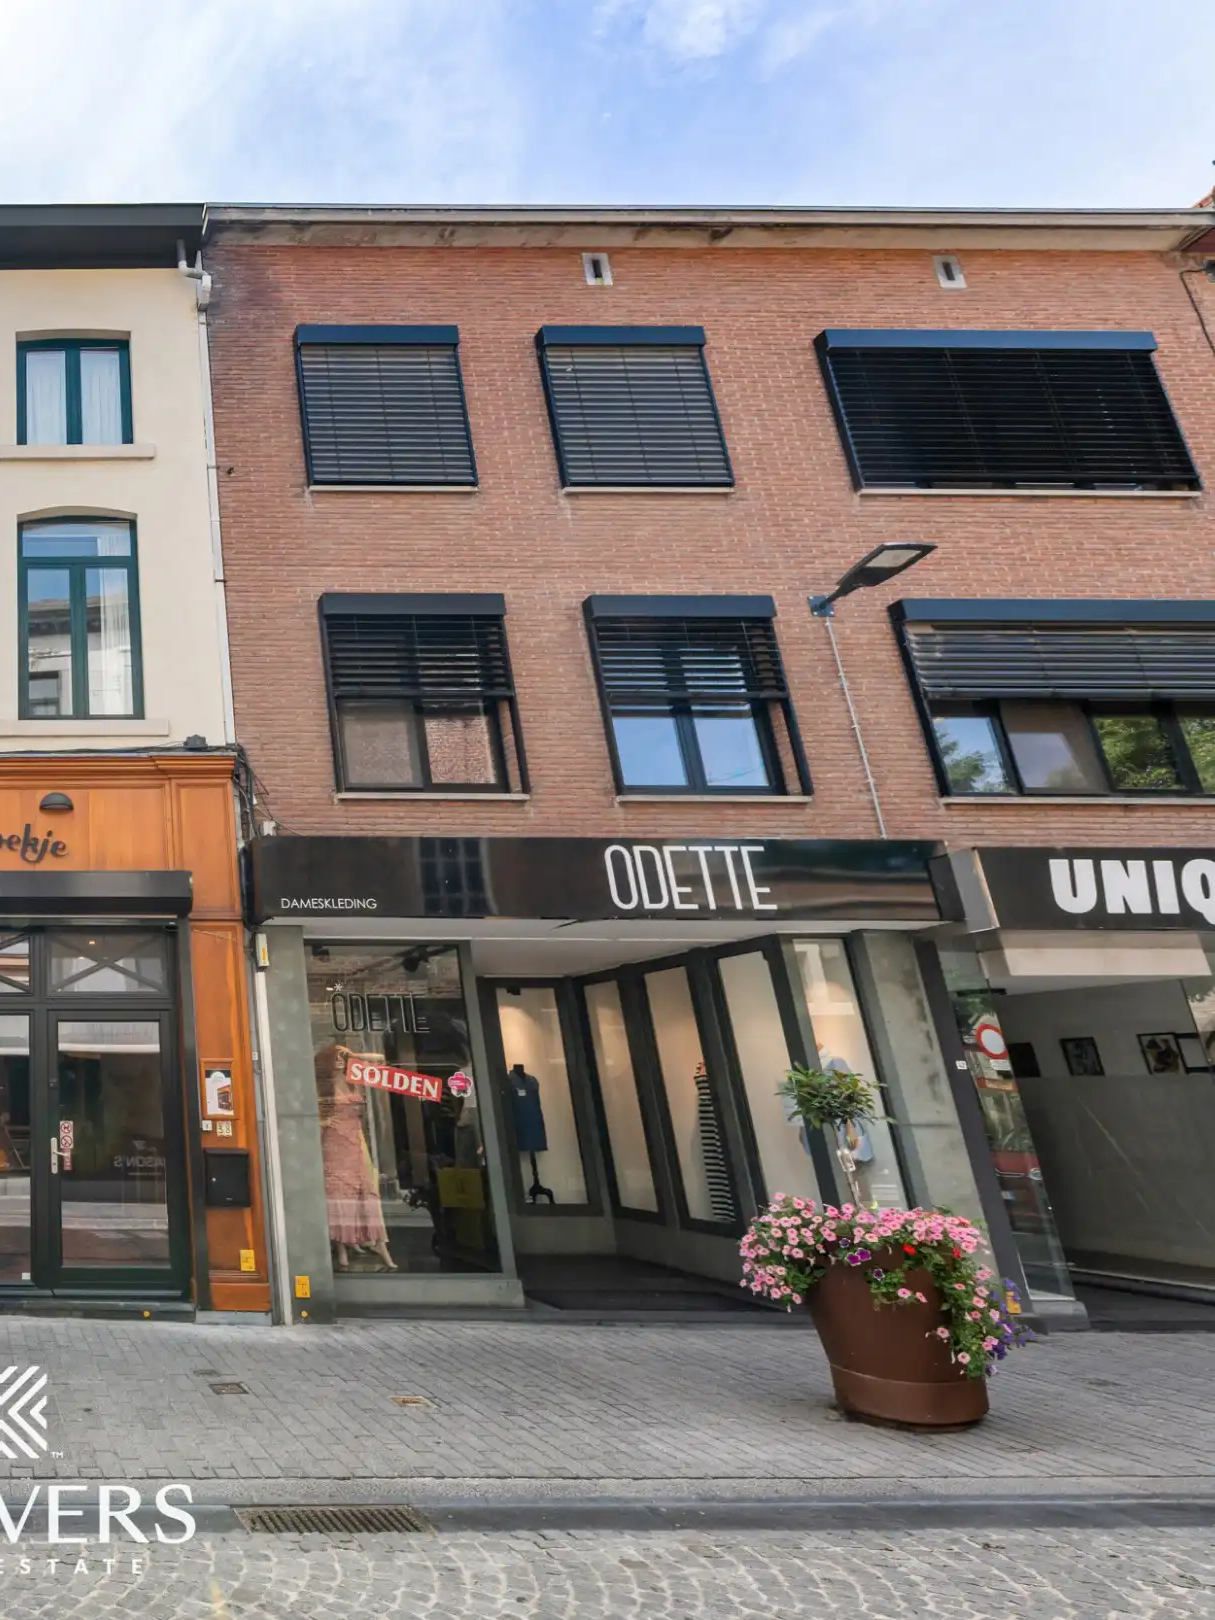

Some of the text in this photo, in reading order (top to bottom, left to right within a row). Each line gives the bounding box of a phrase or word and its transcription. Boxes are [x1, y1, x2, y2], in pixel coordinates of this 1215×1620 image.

[604, 844, 778, 911] ODETTE
[1049, 858, 1215, 925] UNIQ
[280, 897, 378, 910] DAMESKLEDING
[331, 993, 431, 1033] ODETTE
[350, 1063, 439, 1098] SOLDEN
